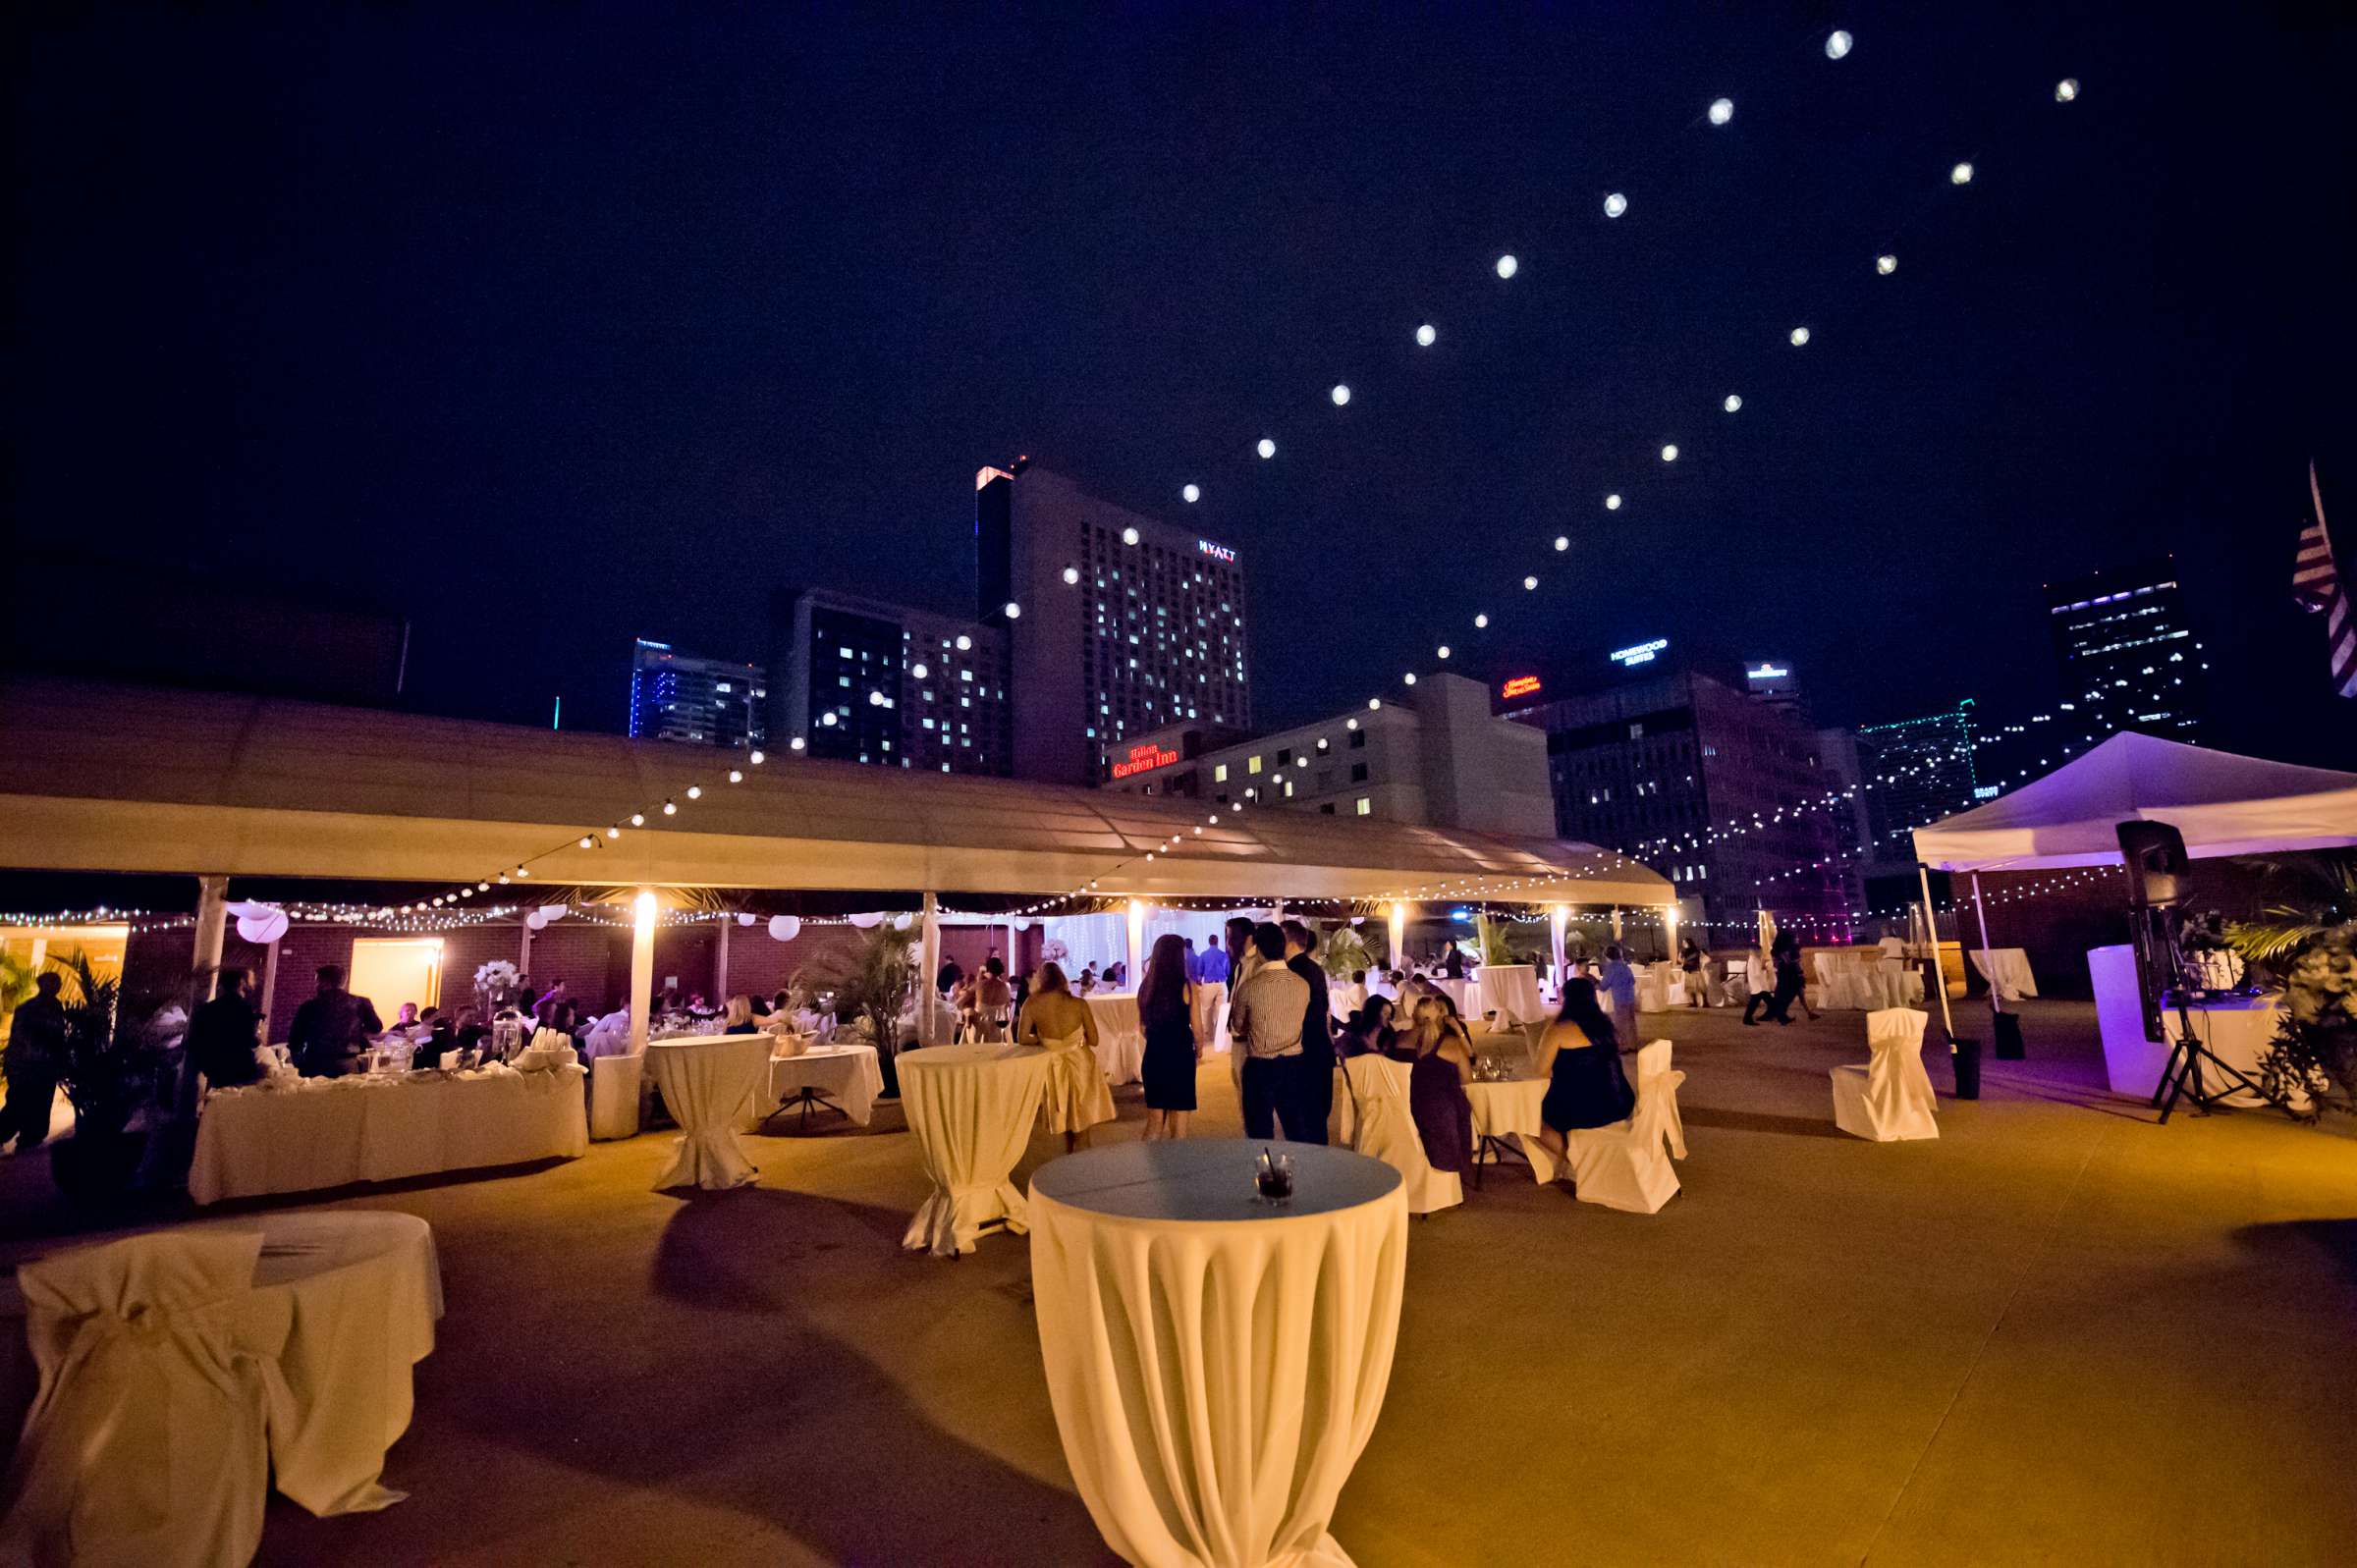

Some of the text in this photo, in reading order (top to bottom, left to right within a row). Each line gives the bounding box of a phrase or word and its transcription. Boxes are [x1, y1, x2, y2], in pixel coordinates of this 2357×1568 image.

[1199, 540, 1235, 562] HYATT
[1611, 639, 1668, 661] HOMEWOOD
[1130, 745, 1158, 759] Hilton
[1114, 750, 1178, 778] Garden Inn
